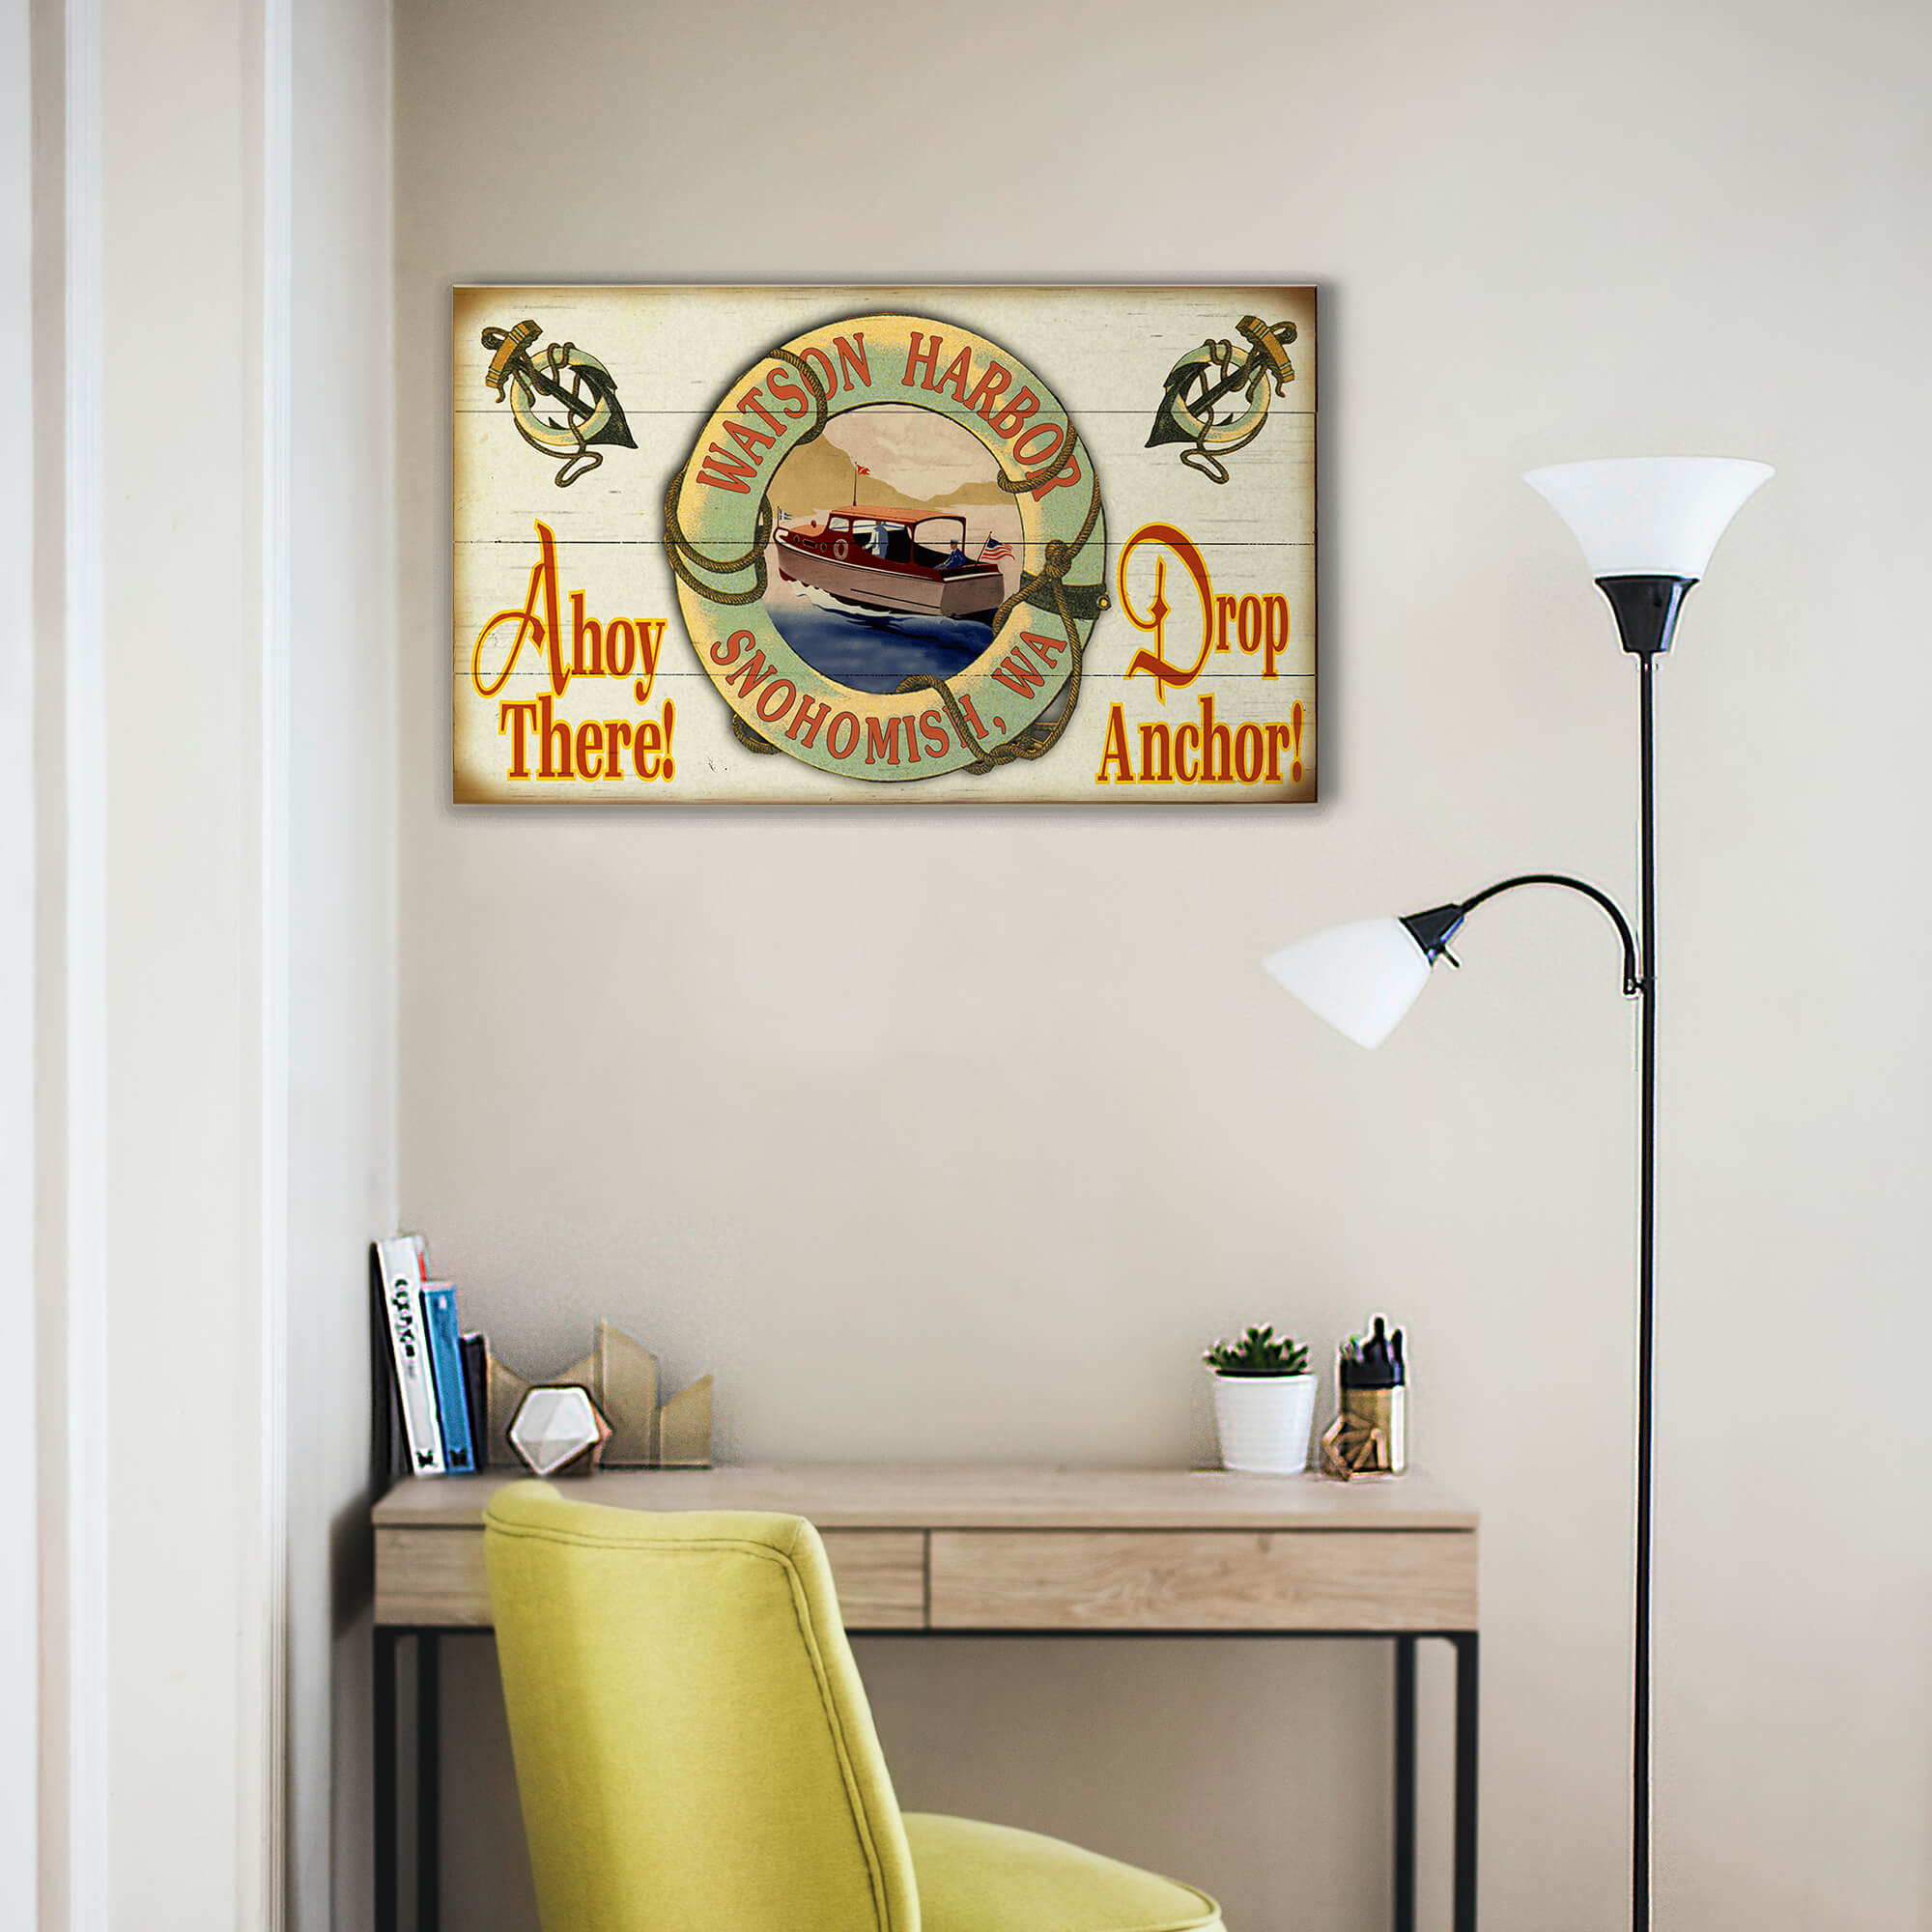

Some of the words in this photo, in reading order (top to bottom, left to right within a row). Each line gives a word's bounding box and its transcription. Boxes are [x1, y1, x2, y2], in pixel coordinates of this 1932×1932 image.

[696, 331, 872, 495] WATSON
[901, 331, 1082, 502] HARBOR
[471, 518, 668, 704] Ahoy
[1117, 522, 1291, 706] Drop
[498, 692, 675, 781] There!
[710, 630, 1007, 765] SNOHOMISH,
[991, 629, 1067, 699] WA
[1095, 693, 1305, 784] Anchor!
